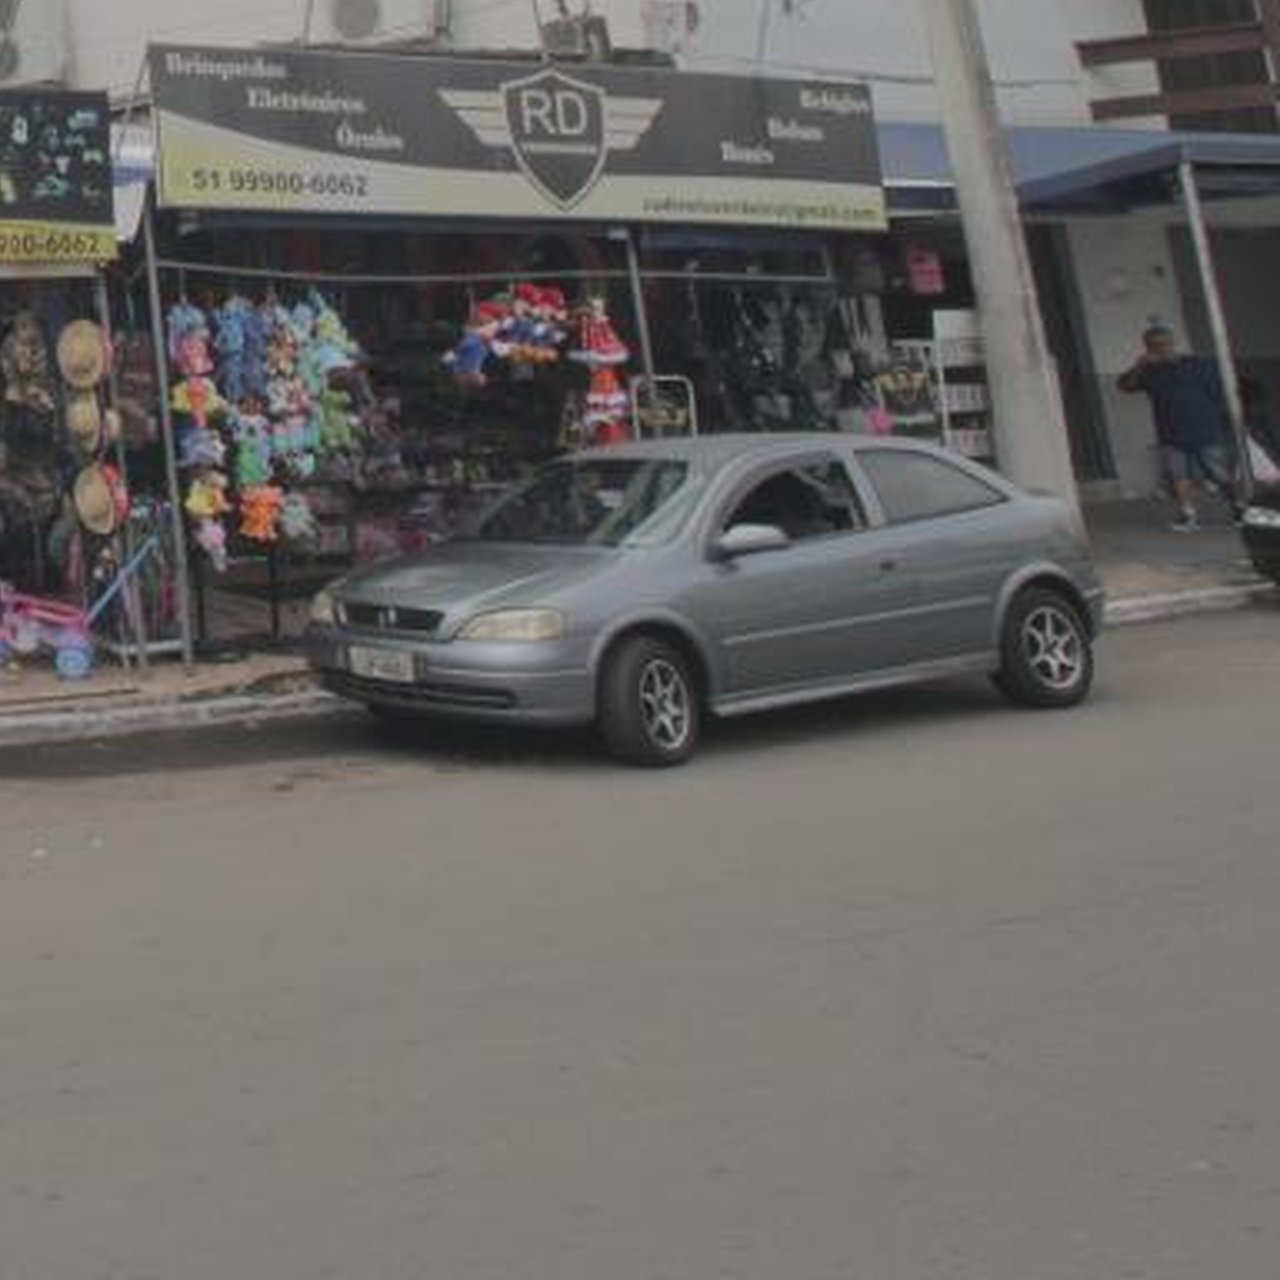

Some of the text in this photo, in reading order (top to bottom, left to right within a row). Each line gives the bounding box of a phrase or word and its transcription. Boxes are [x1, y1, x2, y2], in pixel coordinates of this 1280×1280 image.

[521, 91, 588, 135] RD
[193, 170, 368, 197] 51 99900-6062
